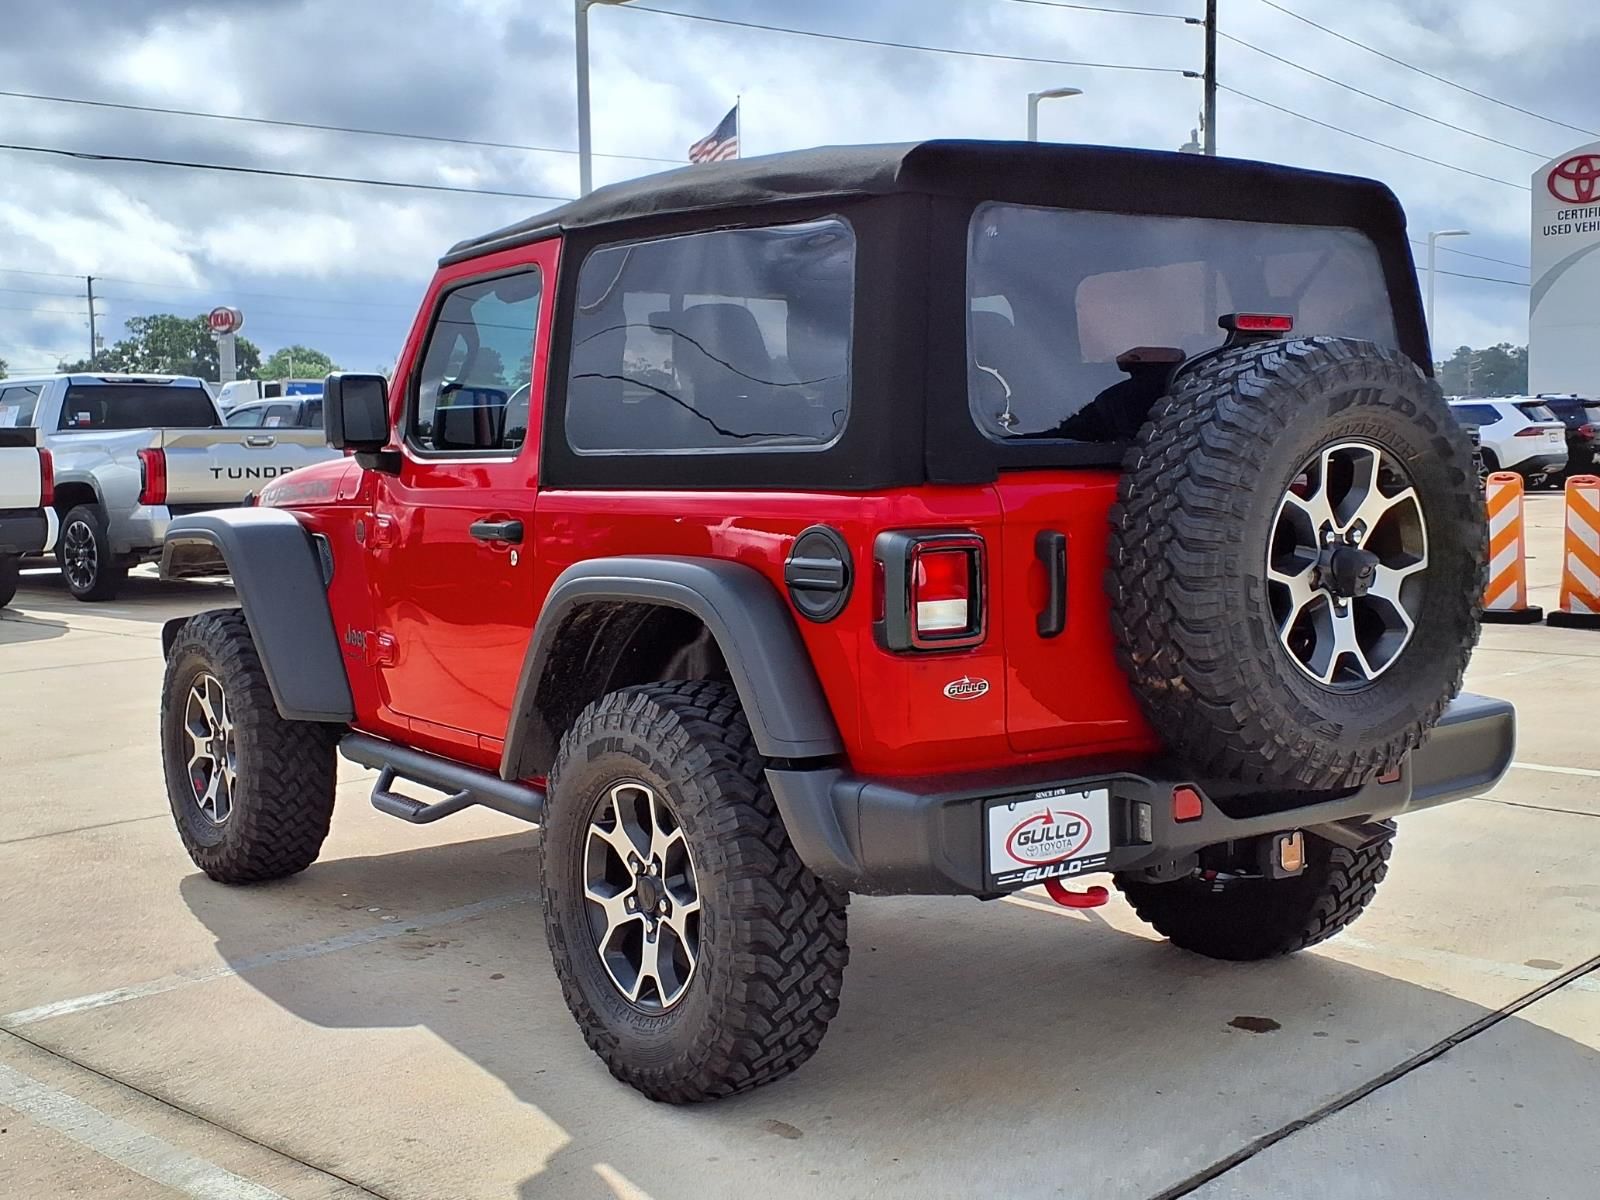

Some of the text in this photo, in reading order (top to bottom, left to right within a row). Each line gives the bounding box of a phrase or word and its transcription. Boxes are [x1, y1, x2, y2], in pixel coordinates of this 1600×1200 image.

[1557, 207, 1600, 221] CERTIFI
[1543, 223, 1572, 236] USED
[212, 312, 231, 327] KIA
[209, 466, 304, 480] TUNDR
[948, 682, 987, 695] GULLO
[1017, 821, 1082, 846] GULLO
[1039, 838, 1073, 852] TOYOTA
[1021, 860, 1082, 882] GULLO
